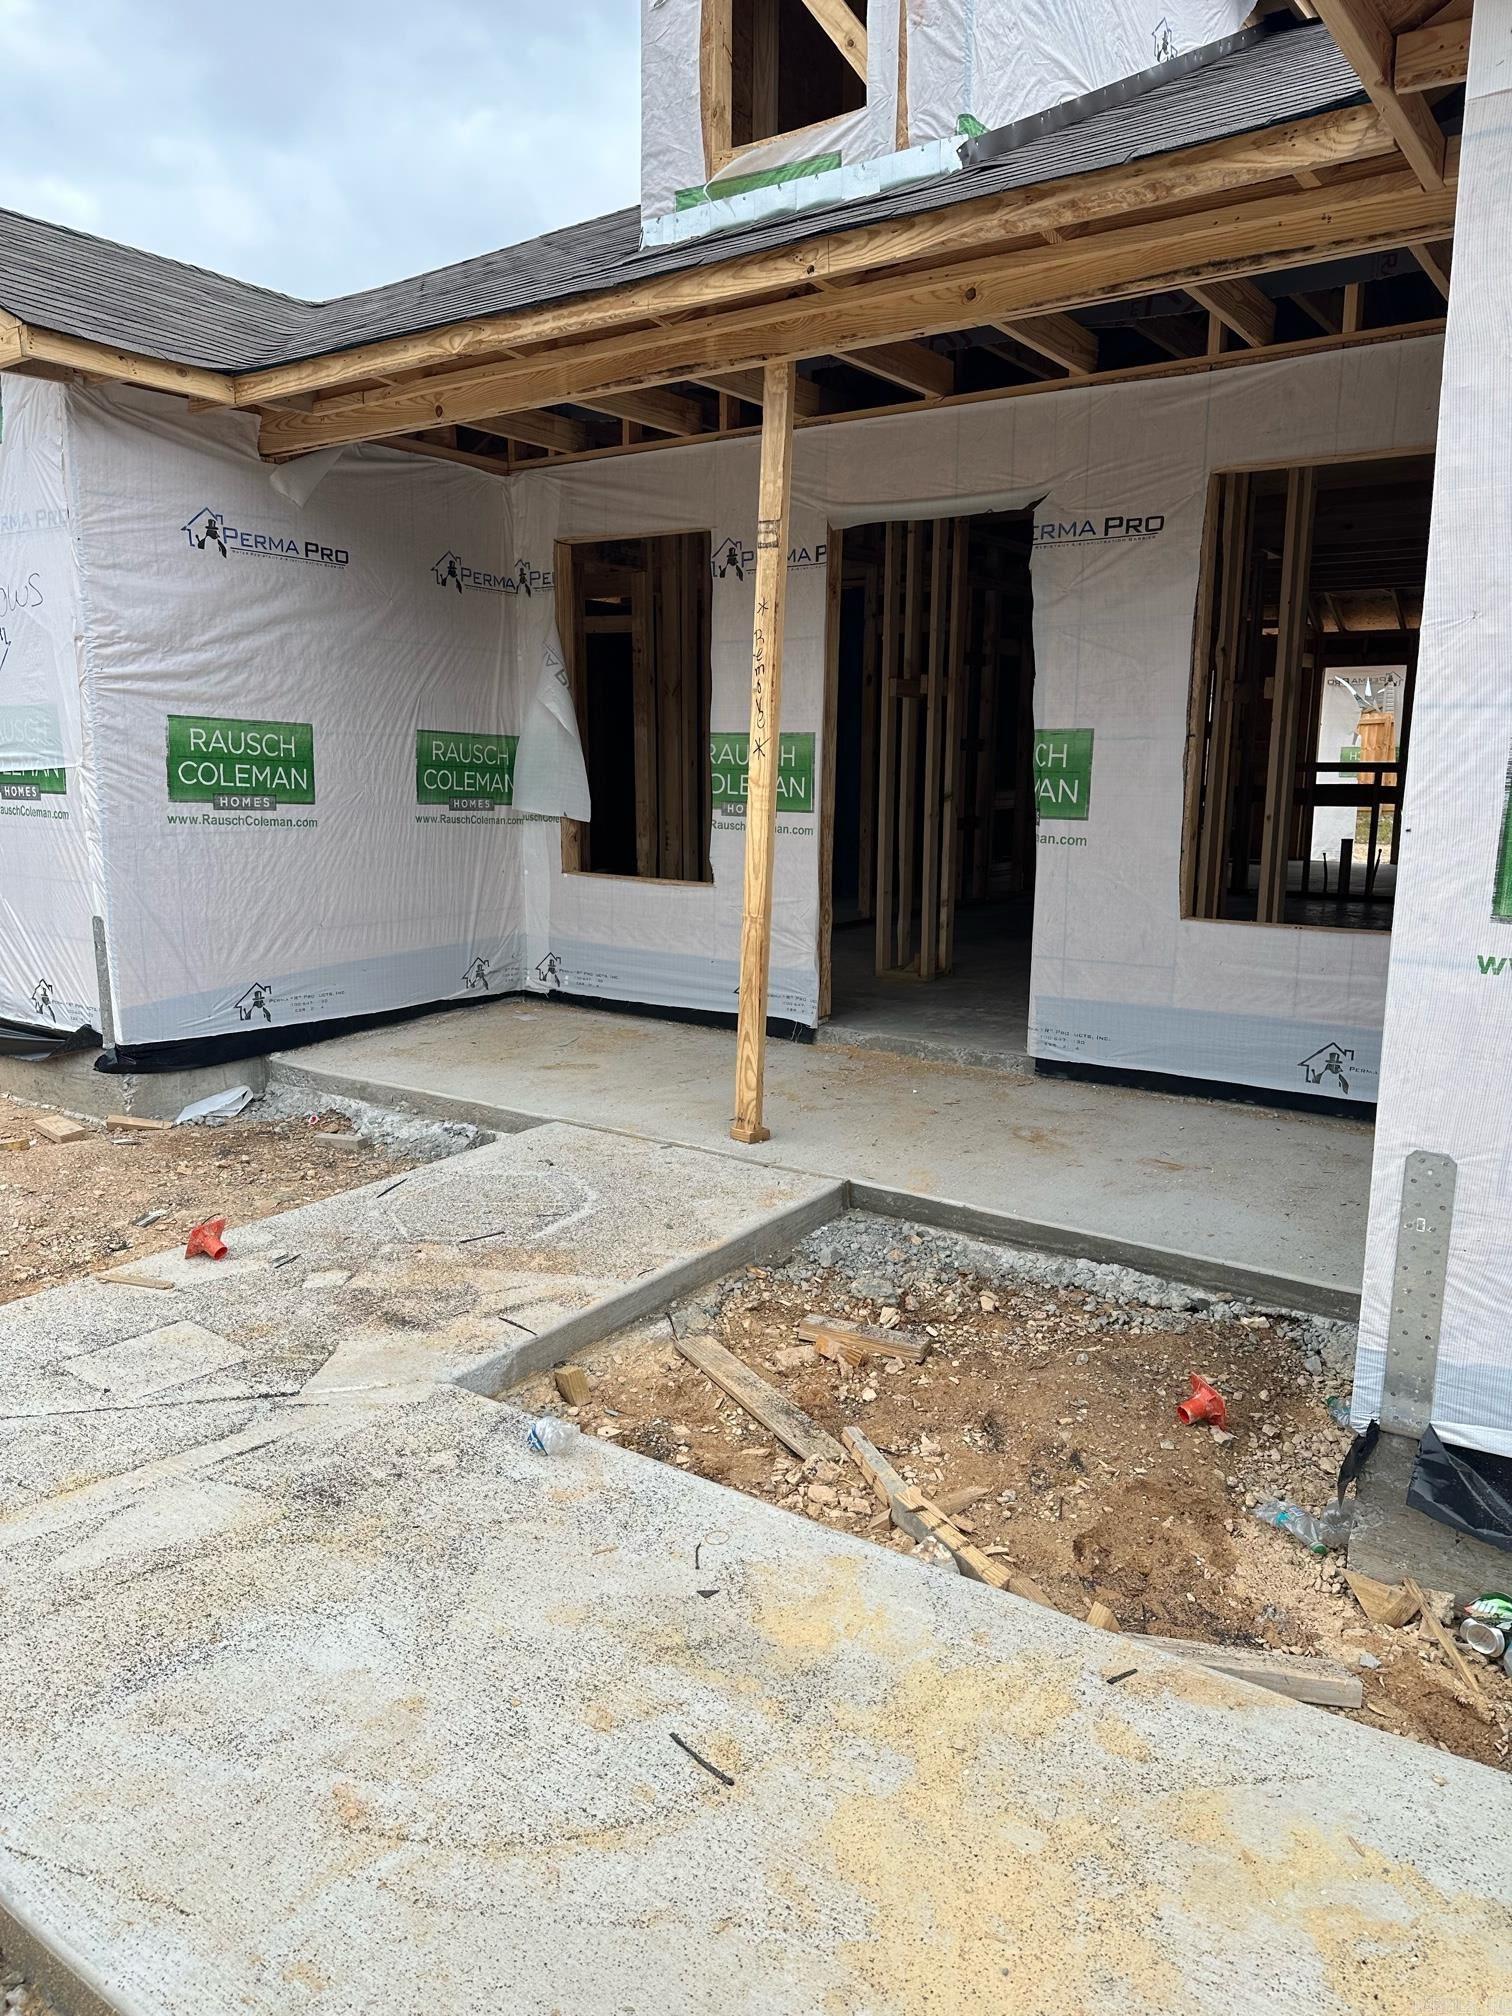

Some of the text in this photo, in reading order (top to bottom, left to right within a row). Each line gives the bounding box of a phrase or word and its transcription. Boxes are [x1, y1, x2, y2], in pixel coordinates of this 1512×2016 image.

[1104, 516, 1165, 537] PRO
[222, 527, 300, 555] PERMA
[304, 542, 349, 565] PRO
[461, 567, 516, 590] PERMA
[190, 728, 296, 757] RAUSCH
[432, 741, 509, 766] RAUSCH
[178, 761, 307, 790] COLEMAN
[424, 769, 514, 793] COLEMAN
[4, 786, 37, 797] HOMES
[220, 797, 271, 808] HOMES
[453, 800, 490, 809] HOMES
[167, 814, 318, 828] www.RauschColeman.com
[415, 814, 524, 826] www.RauschColeman.com
